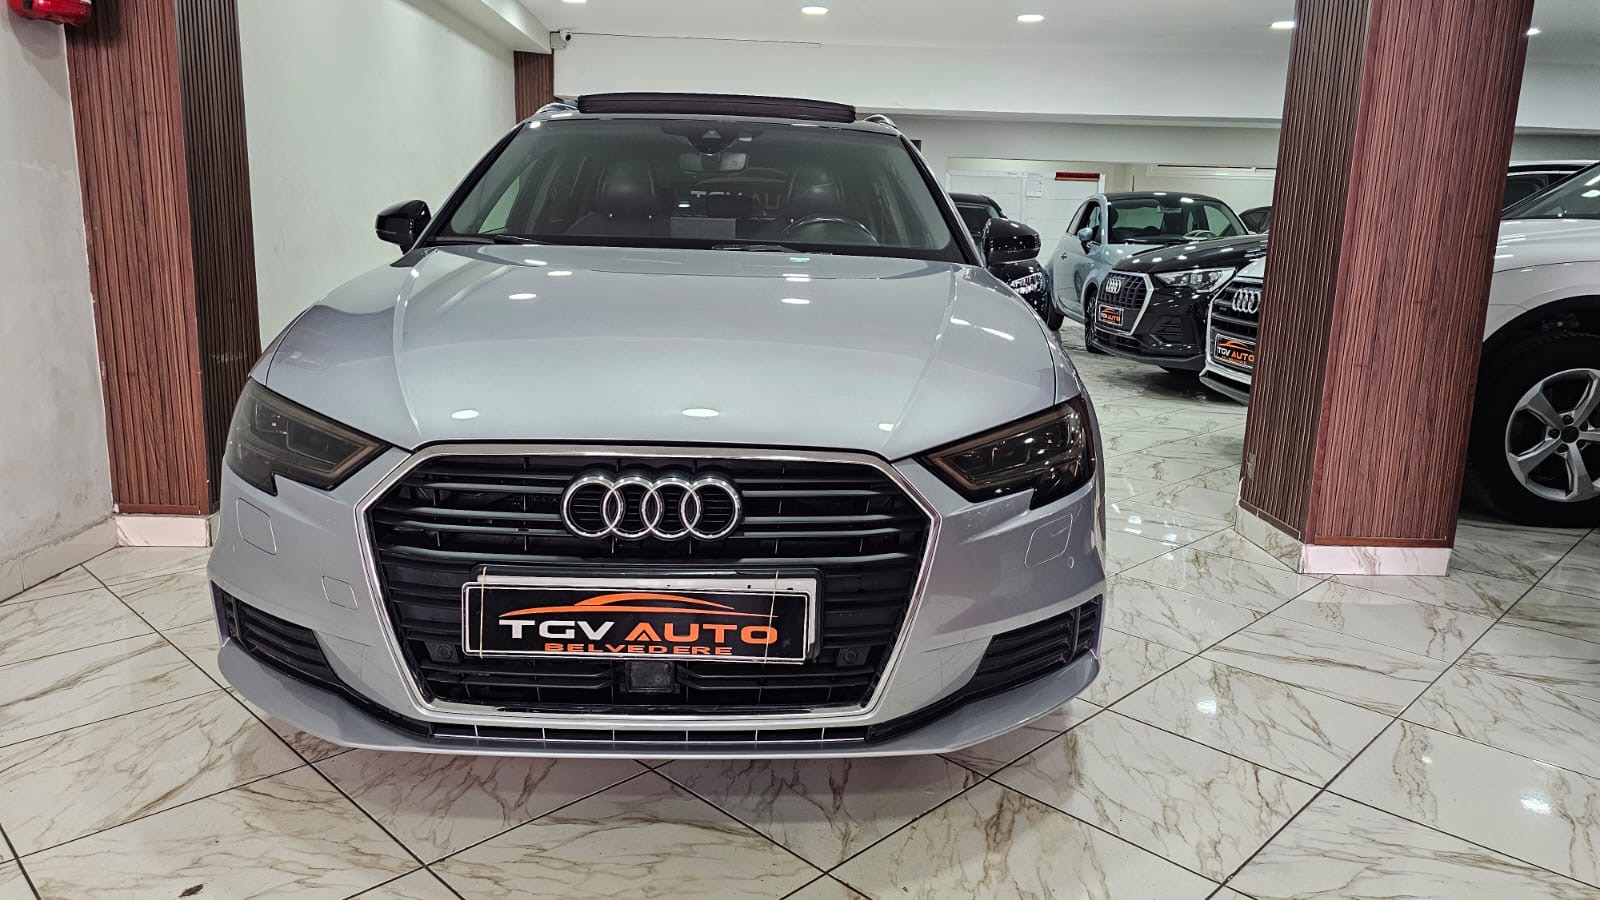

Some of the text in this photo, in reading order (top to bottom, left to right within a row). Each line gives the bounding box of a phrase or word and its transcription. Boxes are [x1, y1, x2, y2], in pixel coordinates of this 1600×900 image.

[1217, 346, 1231, 357] TGV
[1231, 351, 1255, 362] AUTO
[498, 619, 779, 645] TGV AUTO
[544, 642, 734, 656] BELVEDERE
